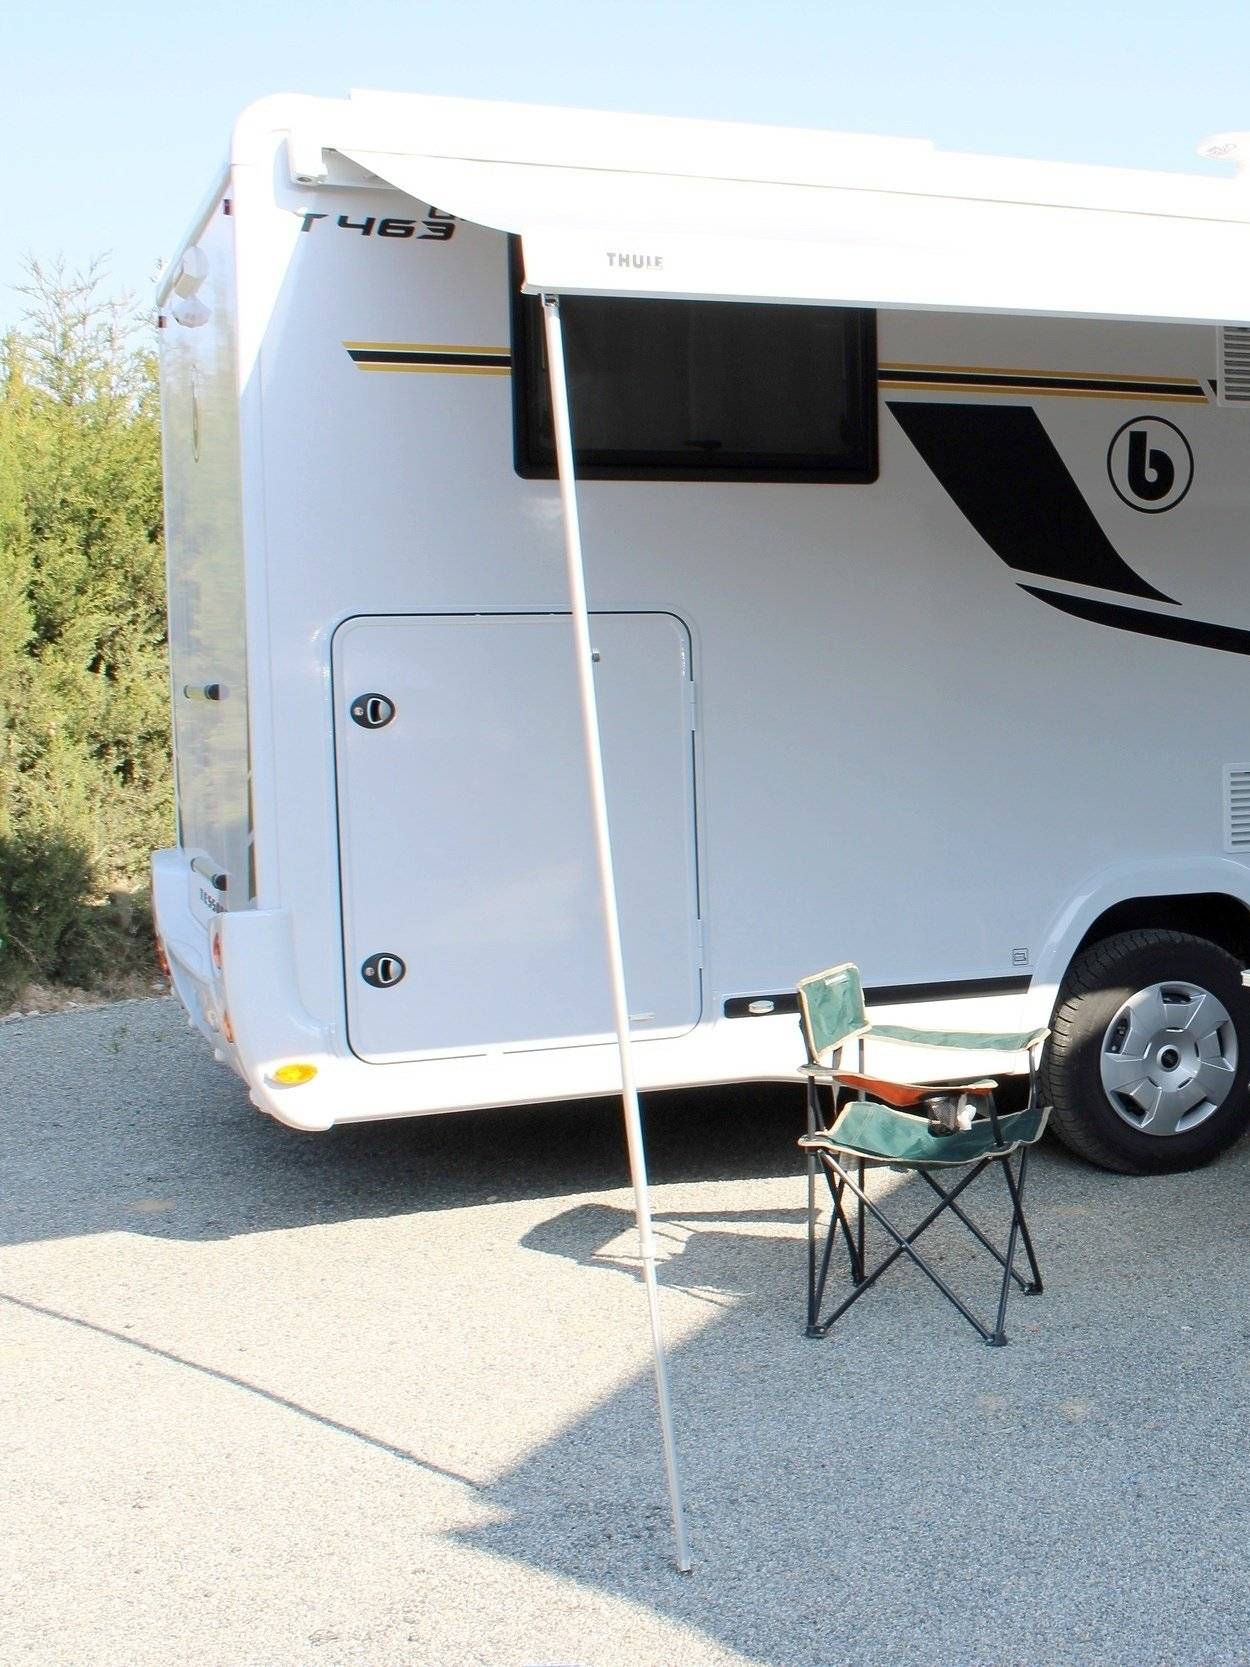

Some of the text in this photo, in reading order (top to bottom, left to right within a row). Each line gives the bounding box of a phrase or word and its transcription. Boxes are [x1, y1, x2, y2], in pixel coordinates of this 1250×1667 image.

[337, 215, 456, 241] 463
[606, 252, 664, 269] THULE
[1128, 430, 1175, 501] b
